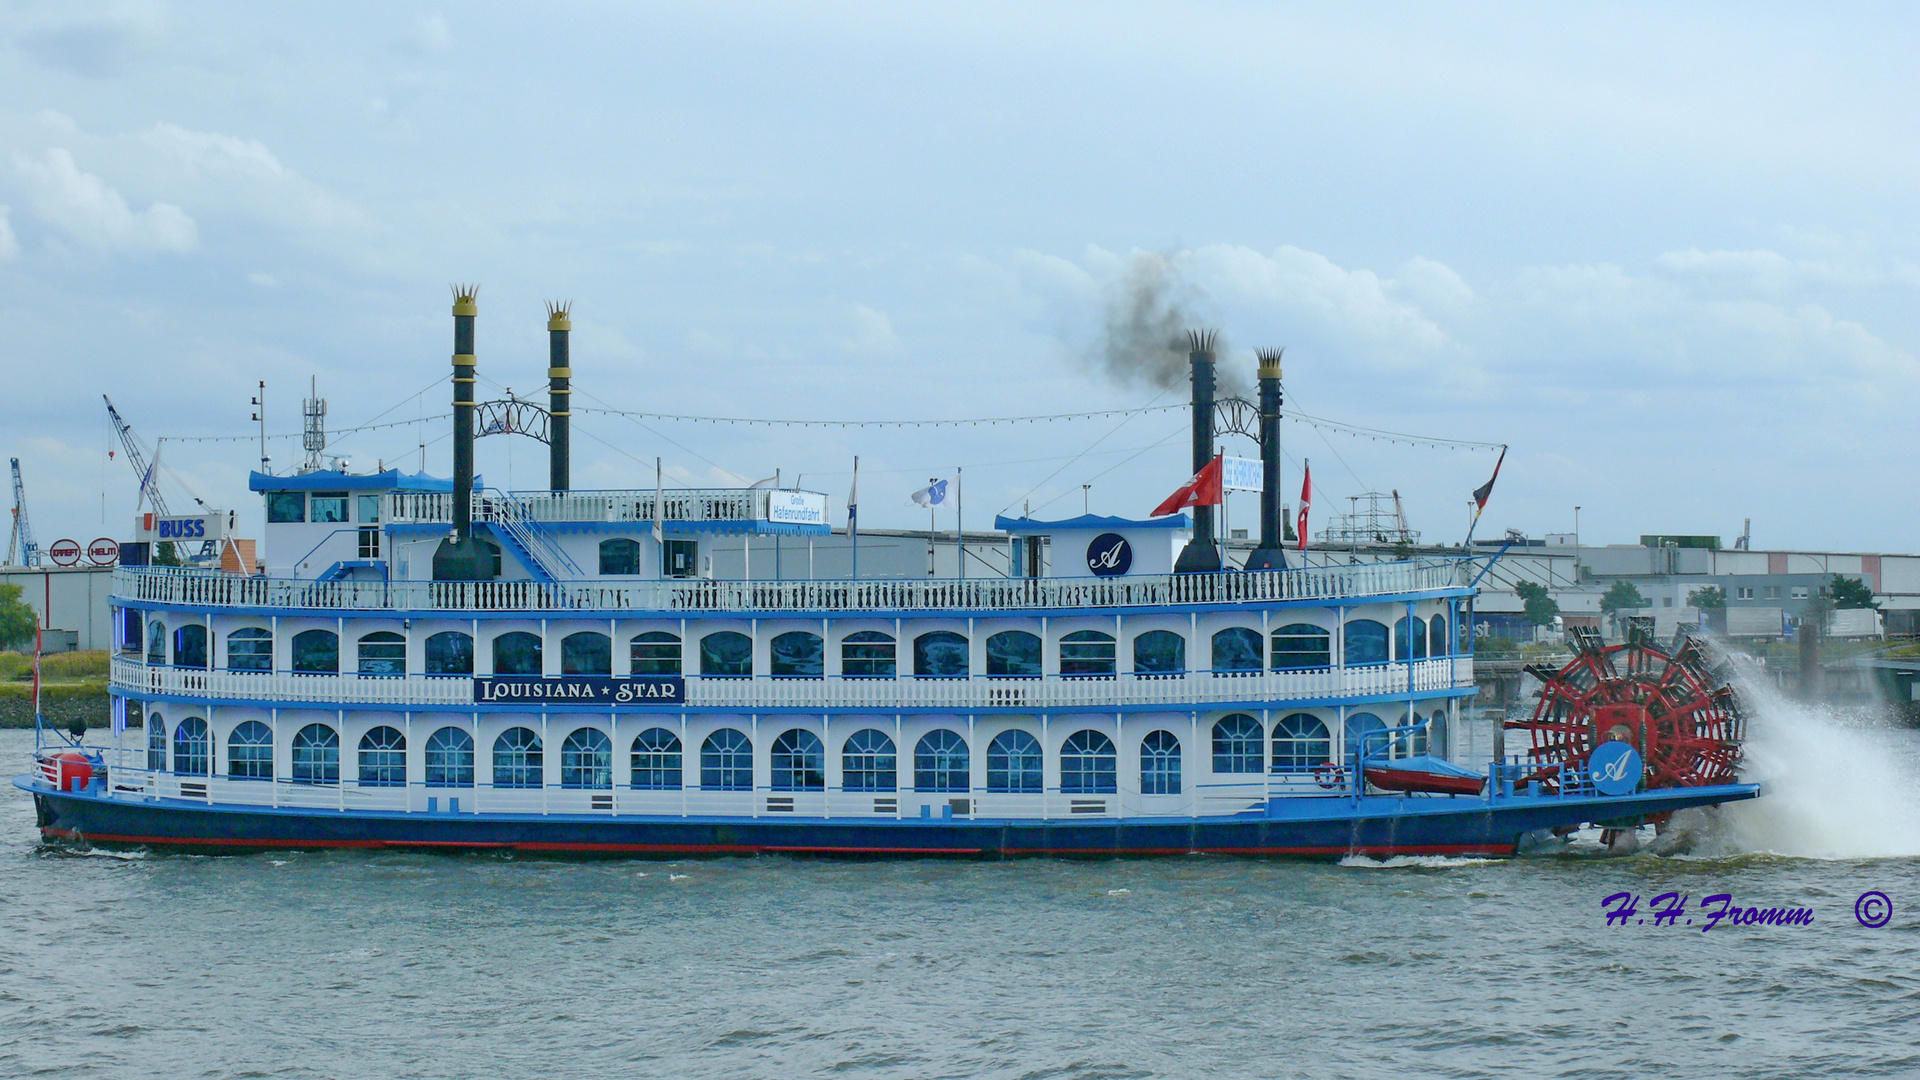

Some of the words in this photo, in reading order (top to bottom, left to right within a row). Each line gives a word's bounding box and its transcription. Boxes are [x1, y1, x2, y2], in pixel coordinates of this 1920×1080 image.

[774, 505, 820, 521] Hafenrundfahrt
[159, 519, 205, 538] BUSS
[91, 547, 116, 556] HELM
[481, 681, 595, 701] LOUISIANA
[615, 683, 676, 702] STAR
